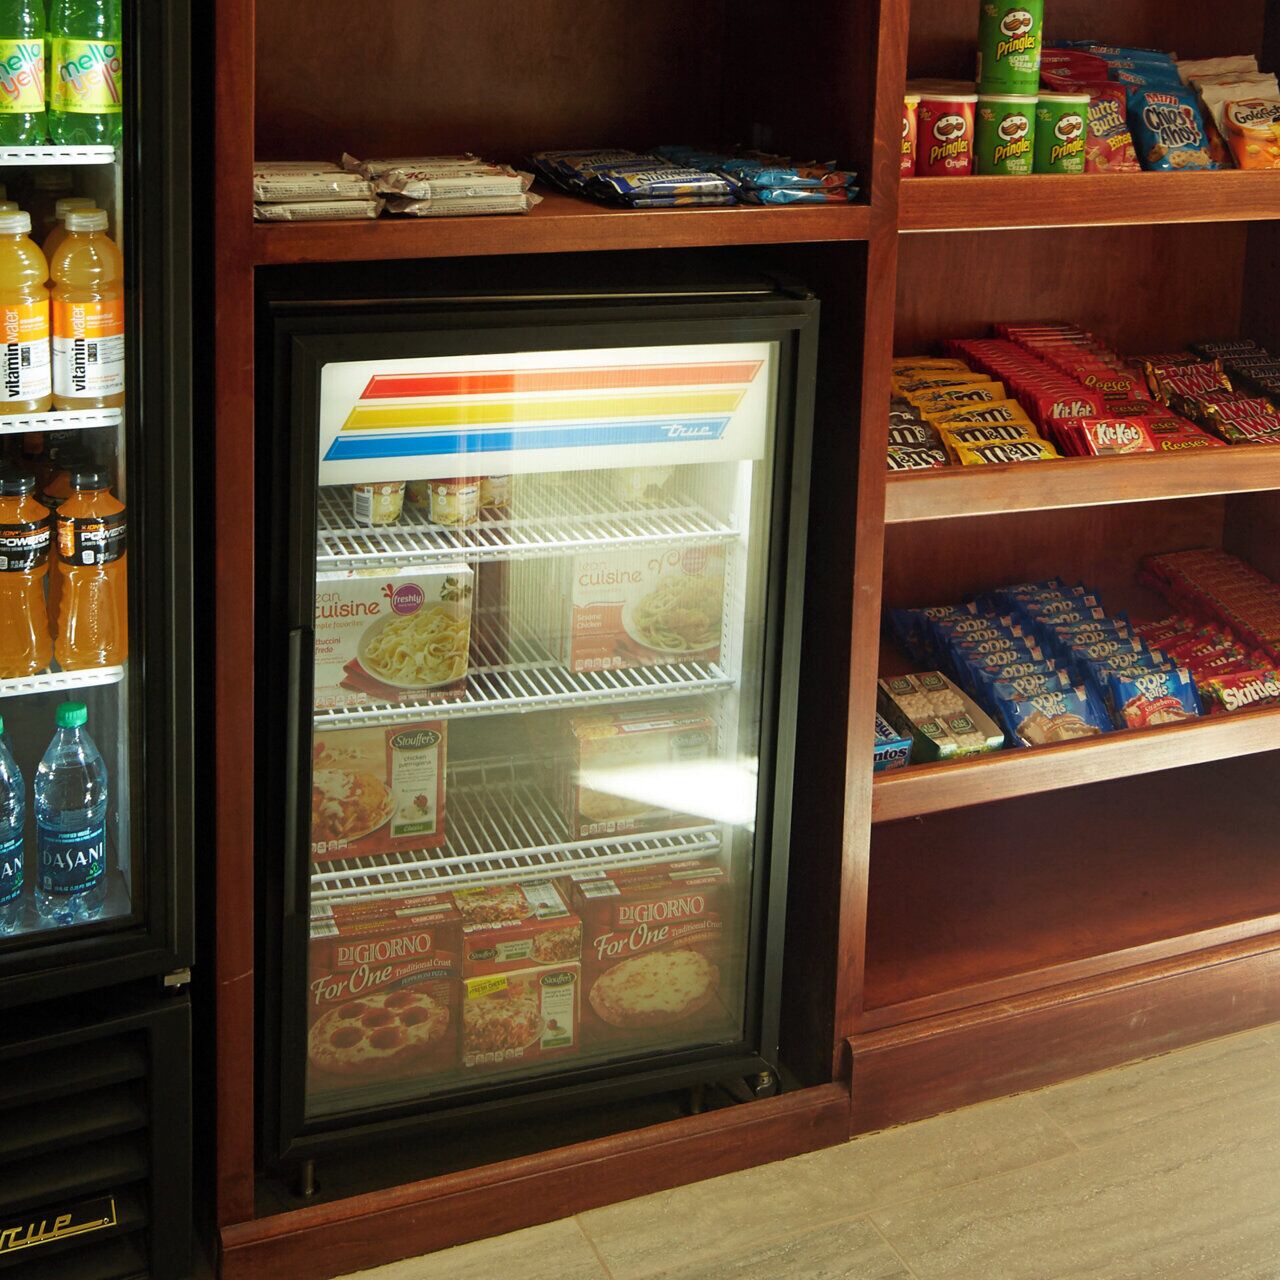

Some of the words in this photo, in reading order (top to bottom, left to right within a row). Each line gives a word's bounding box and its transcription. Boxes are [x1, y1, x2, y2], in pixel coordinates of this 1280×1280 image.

[996, 33, 1036, 61] Pringles
[60, 44, 116, 82] mello
[71, 58, 120, 104] yello
[1145, 107, 1187, 130] Chips
[930, 138, 968, 165] Pringles
[994, 138, 1031, 165] Pringles
[1107, 132, 1132, 151] Bites
[5, 310, 21, 398] vitaminwater
[72, 305, 87, 392] vitaminwater
[1167, 372, 1223, 395] TWIX
[1217, 397, 1269, 420] TWIX
[661, 424, 713, 437] true
[975, 441, 1044, 465] m&m
[579, 569, 642, 587] cuisine
[315, 592, 342, 602] ean
[394, 593, 422, 605] freshly
[577, 621, 602, 629] Chicken
[1145, 698, 1177, 712] Strawberry
[396, 731, 436, 747] Stouffer's
[43, 841, 103, 872] DASANI
[593, 932, 628, 961] For
[629, 923, 669, 951] One
[672, 920, 707, 937] Traditional
[310, 974, 348, 1006] For
[349, 964, 393, 994] One
[395, 959, 433, 977] Traditional
[433, 958, 452, 968] Crust
[543, 973, 573, 985] Stouffer's
